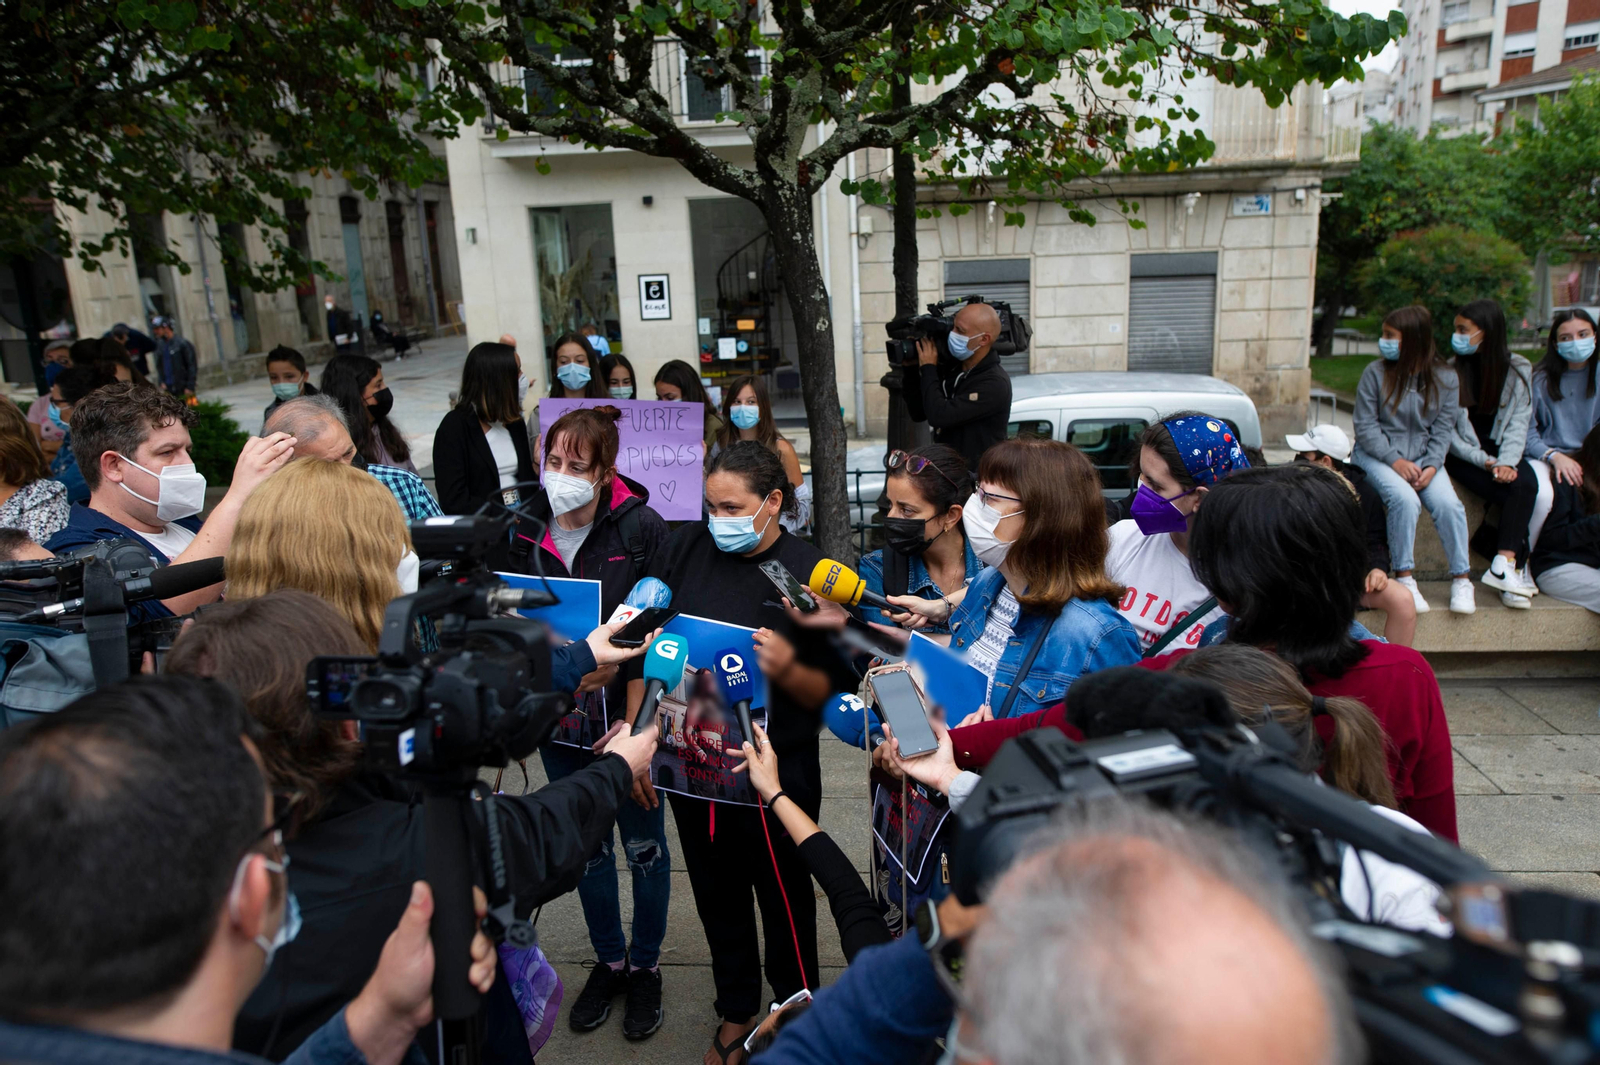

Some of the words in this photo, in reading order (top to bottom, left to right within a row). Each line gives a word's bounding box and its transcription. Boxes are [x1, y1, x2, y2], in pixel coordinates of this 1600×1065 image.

[627, 444, 697, 473] PUEDES
[821, 564, 842, 596] SER
[680, 765, 737, 787] CONTIGO
